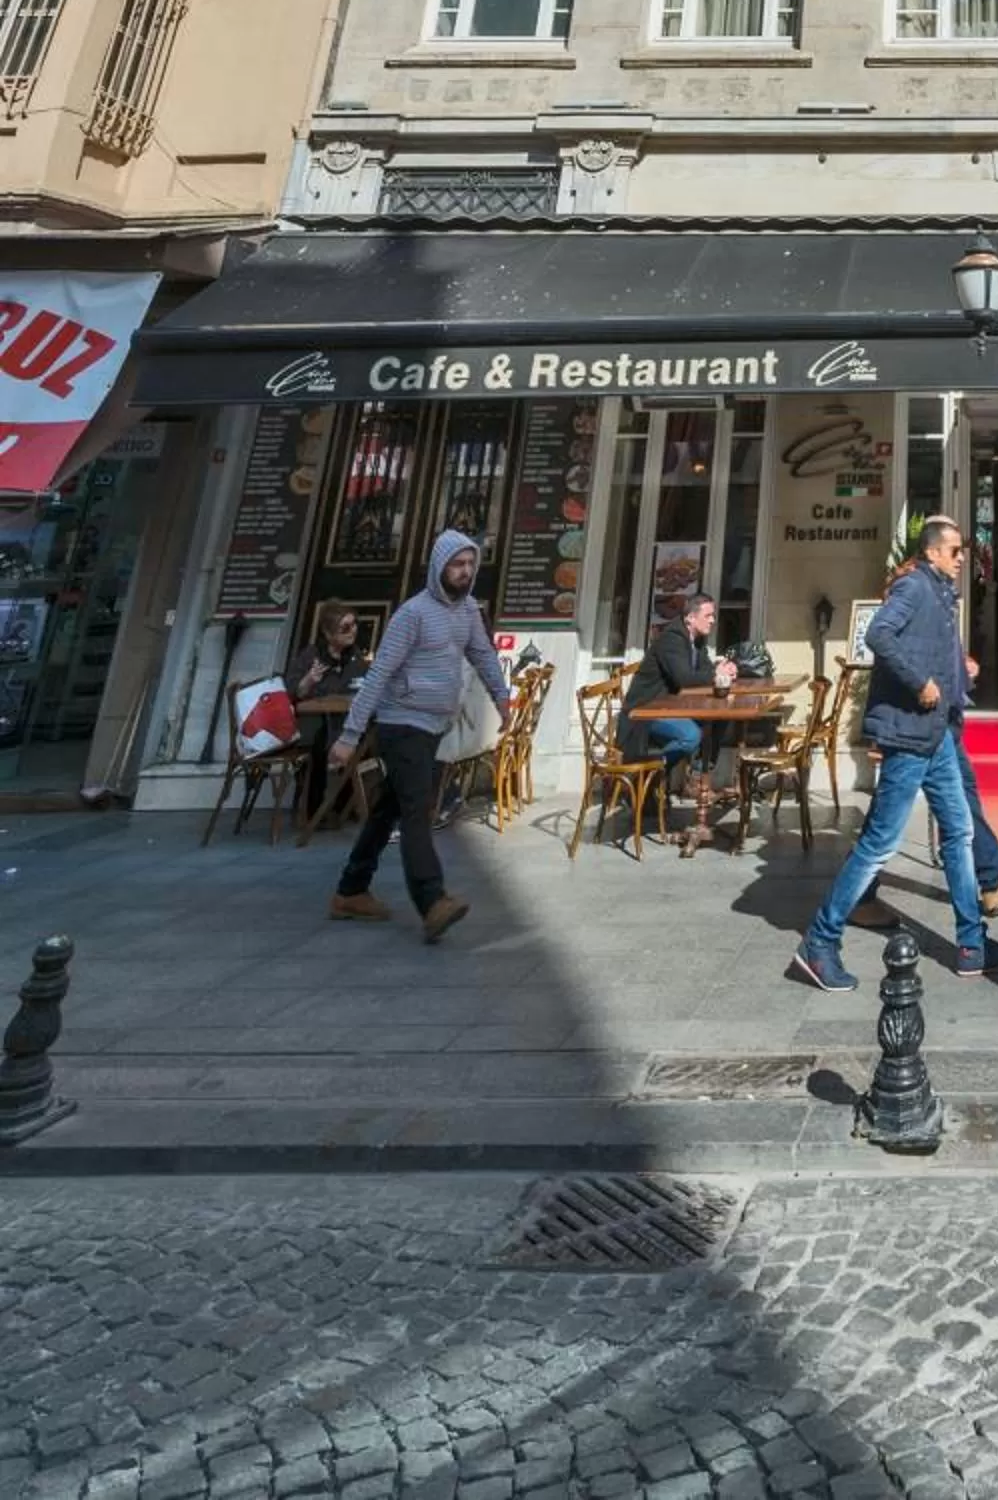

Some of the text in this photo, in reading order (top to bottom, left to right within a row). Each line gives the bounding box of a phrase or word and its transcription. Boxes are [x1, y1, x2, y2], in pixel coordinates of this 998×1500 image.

[369, 355, 471, 391] Cafe
[484, 353, 513, 389] &
[528, 349, 779, 389] Restaurant
[812, 504, 853, 520] Cafe
[784, 524, 879, 541] Restaurant
